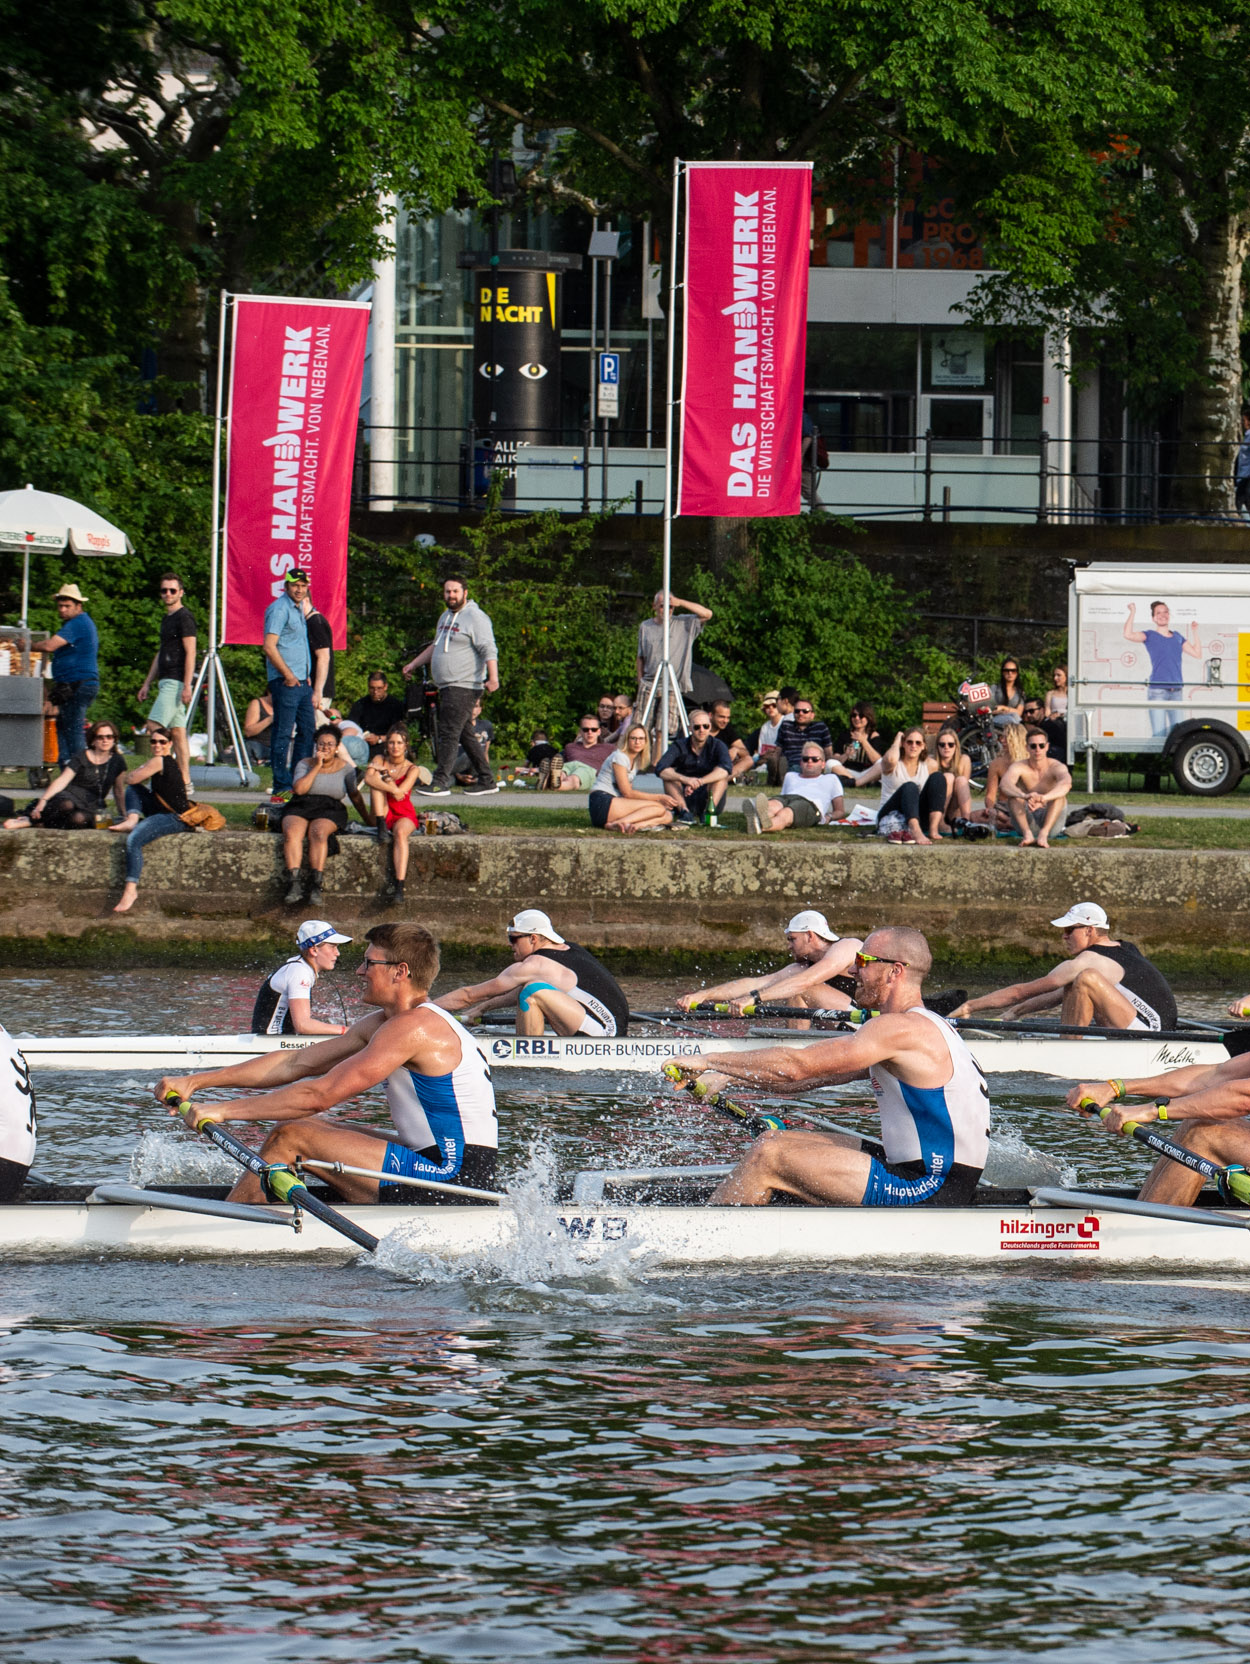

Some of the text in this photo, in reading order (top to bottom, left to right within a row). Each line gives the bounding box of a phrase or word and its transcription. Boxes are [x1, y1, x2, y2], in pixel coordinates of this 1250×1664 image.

[480, 287, 509, 304] DE
[757, 187, 777, 497] DIE WIRTSCHAFTSMACHT. VON NEBENAN.
[310, 324, 331, 398] NEBENAN.
[604, 357, 615, 380] P
[306, 403, 323, 433] VON
[727, 422, 758, 497] DAS
[971, 688, 988, 700] DB
[515, 1039, 702, 1056] RBL RUDER-BUNDESLIGA
[557, 1217, 628, 1240] WB
[1000, 1219, 1076, 1239] hilzinger
